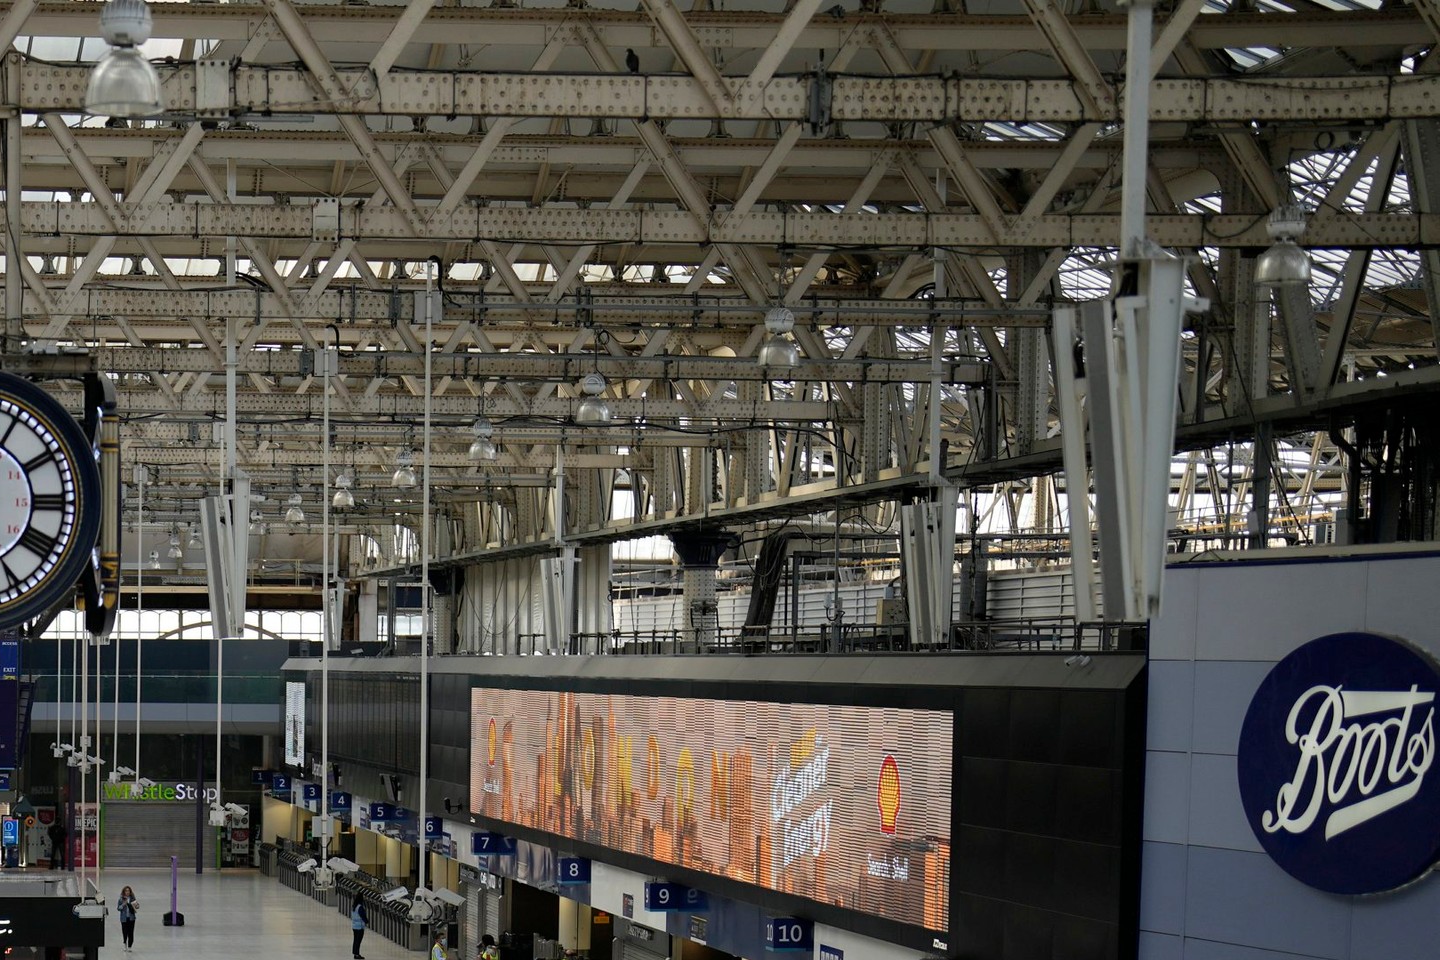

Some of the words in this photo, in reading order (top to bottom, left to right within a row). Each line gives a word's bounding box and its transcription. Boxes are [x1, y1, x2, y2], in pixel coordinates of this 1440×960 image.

[8, 470, 22, 481] 14
[15, 497, 28, 507] 15
[7, 524, 20, 535] 16
[1262, 684, 1436, 842] Boots
[279, 779, 286, 788] 2
[103, 783, 218, 804] WstleStop
[309, 787, 316, 797] 3
[337, 796, 345, 805] 4
[377, 807, 384, 817] 5
[426, 821, 433, 832] 6
[481, 837, 489, 848] 7
[569, 863, 579, 877] 8
[658, 889, 670, 904] 9
[766, 924, 774, 942] 10
[778, 924, 803, 943] 10
